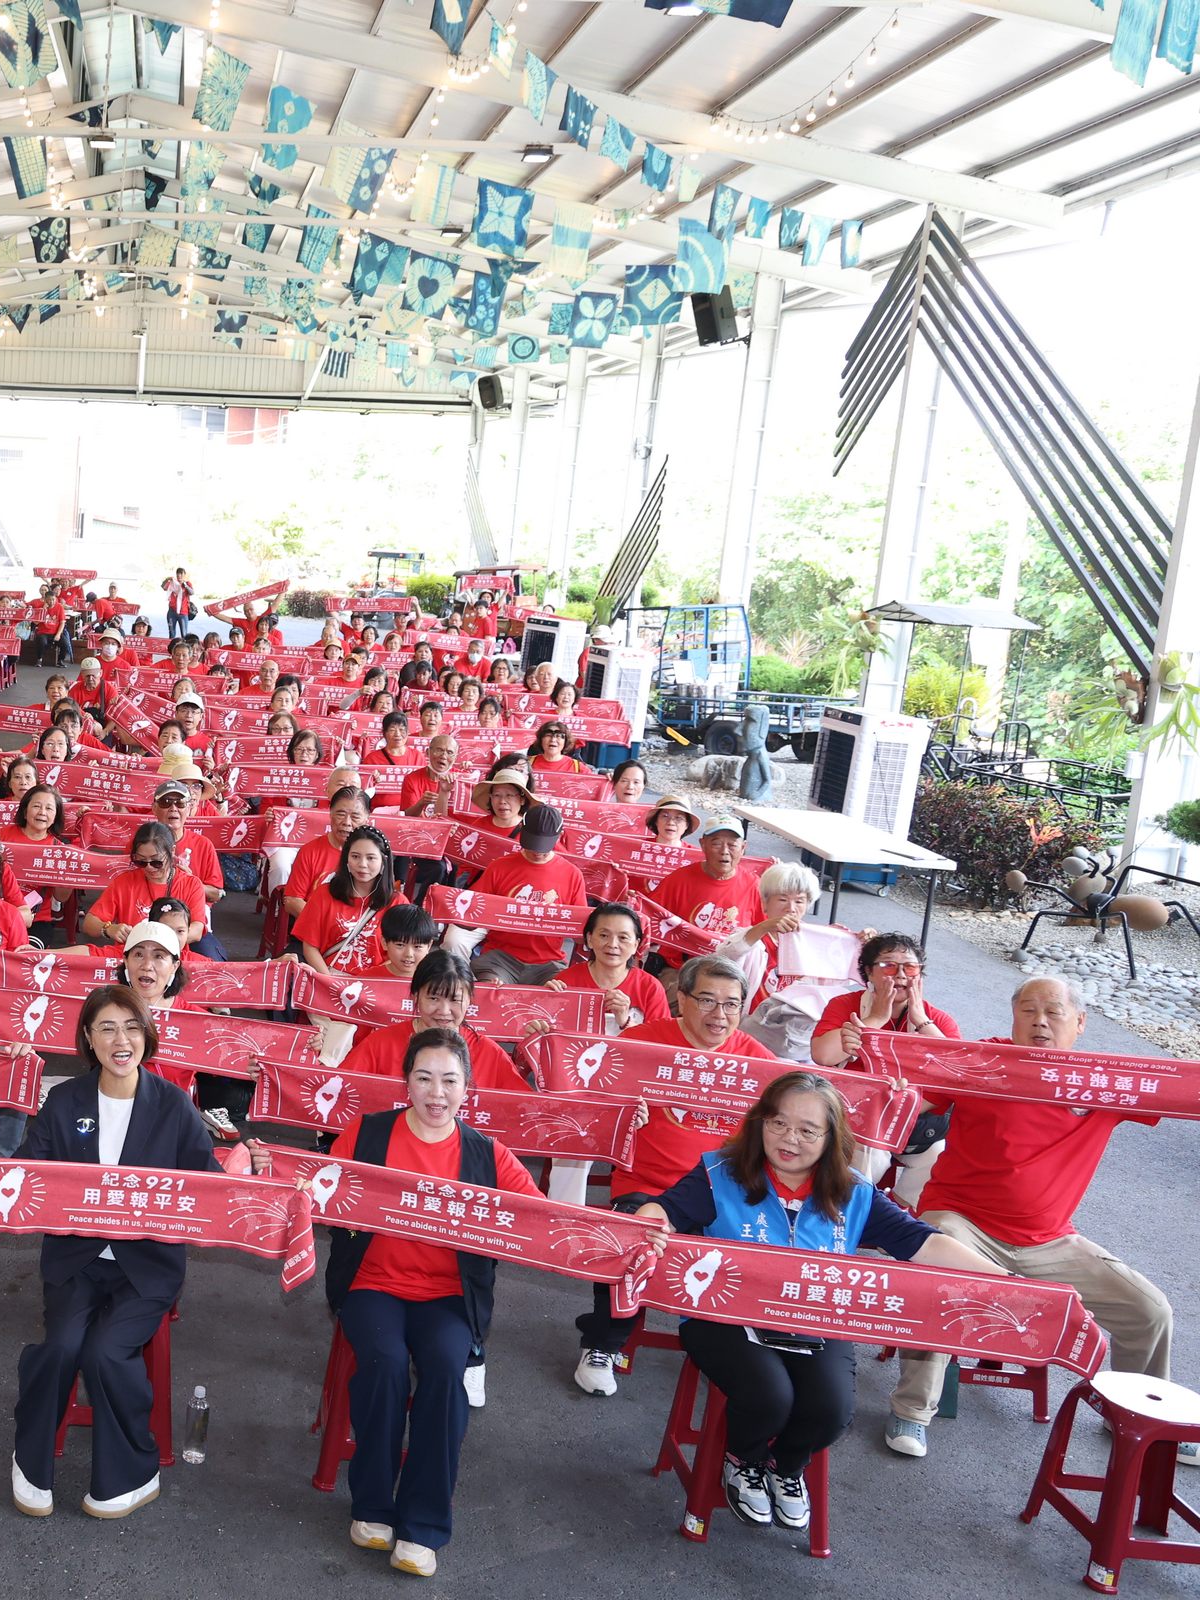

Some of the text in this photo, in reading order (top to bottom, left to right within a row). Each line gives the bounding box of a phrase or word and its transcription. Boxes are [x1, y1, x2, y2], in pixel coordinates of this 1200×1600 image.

[91, 770, 126, 783] 紀念921
[262, 775, 310, 786] 用愛報平安
[269, 768, 305, 777] 紀念921
[83, 778, 131, 793] 用愛報平安
[32, 857, 91, 873] 用愛報平安
[42, 849, 84, 861] 紀念921
[506, 903, 572, 920] 用愛報平安
[673, 1051, 749, 1076] 紀念921
[656, 1065, 759, 1094] 用愛報平安
[643, 1087, 748, 1106] Peace abides in us, along with
[101, 1171, 185, 1192] 紀念921
[416, 1179, 501, 1207] 紀念921
[82, 1187, 196, 1214] 用愛報平安
[399, 1191, 516, 1229] 用愛報平安
[68, 1215, 203, 1235] Peace abides in us, along with you.
[385, 1216, 523, 1253] Peace abides in us, along with you.
[756, 1212, 769, 1243] 處長
[800, 1262, 889, 1290] 紀念921
[780, 1281, 905, 1313] 用愛報平安
[764, 1307, 914, 1337] Peace abides in us, along with you.
